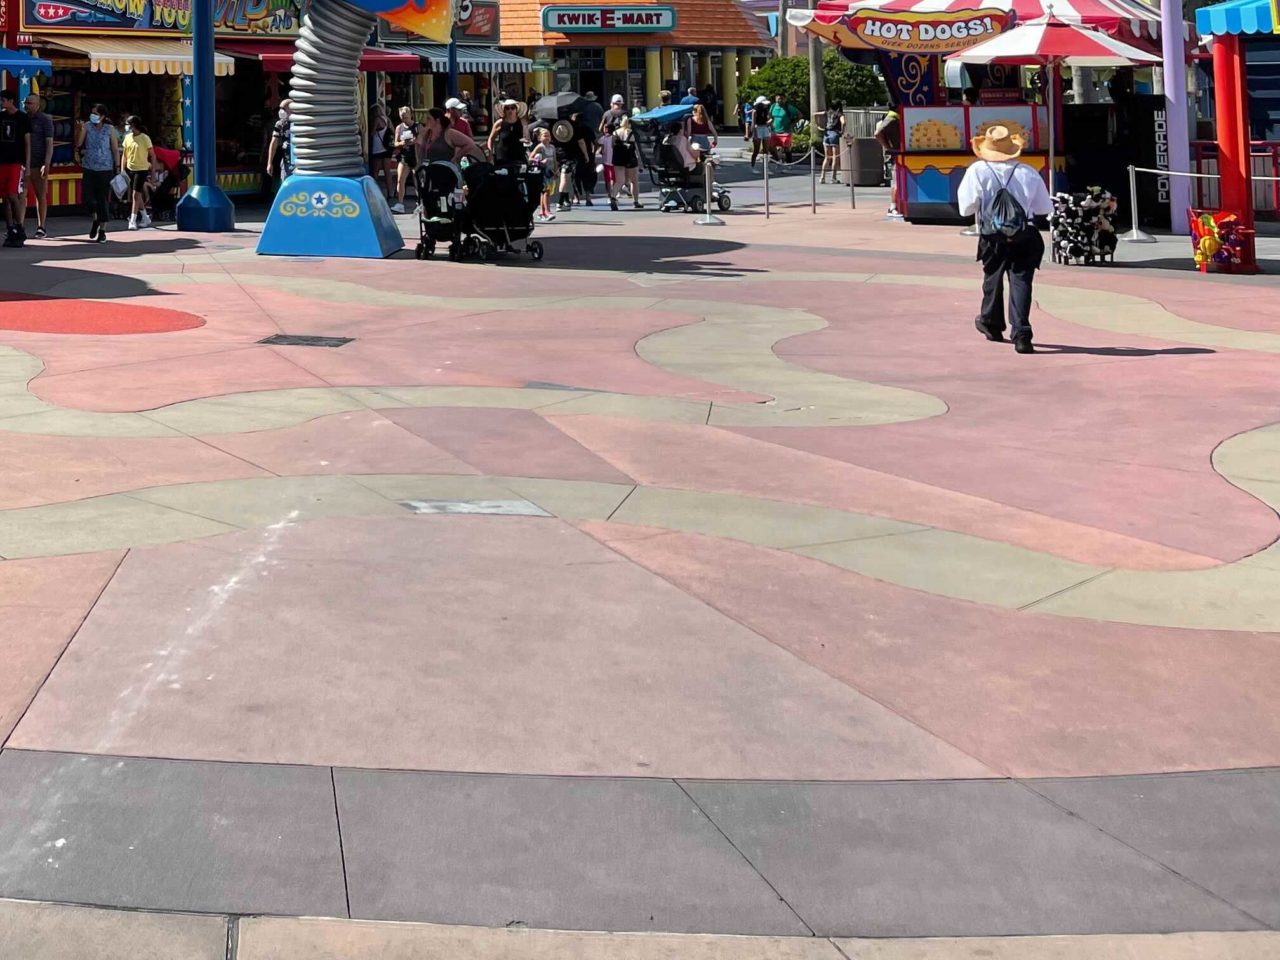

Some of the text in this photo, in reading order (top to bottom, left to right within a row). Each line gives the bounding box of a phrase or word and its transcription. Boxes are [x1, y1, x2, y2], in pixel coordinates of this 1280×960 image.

[557, 9, 663, 28] KWIK-E-MART
[863, 17, 994, 41] HOT DOGS!
[880, 39, 905, 48] OVER
[906, 42, 941, 50] DOZENS
[1153, 110, 1169, 203] POWERADE
